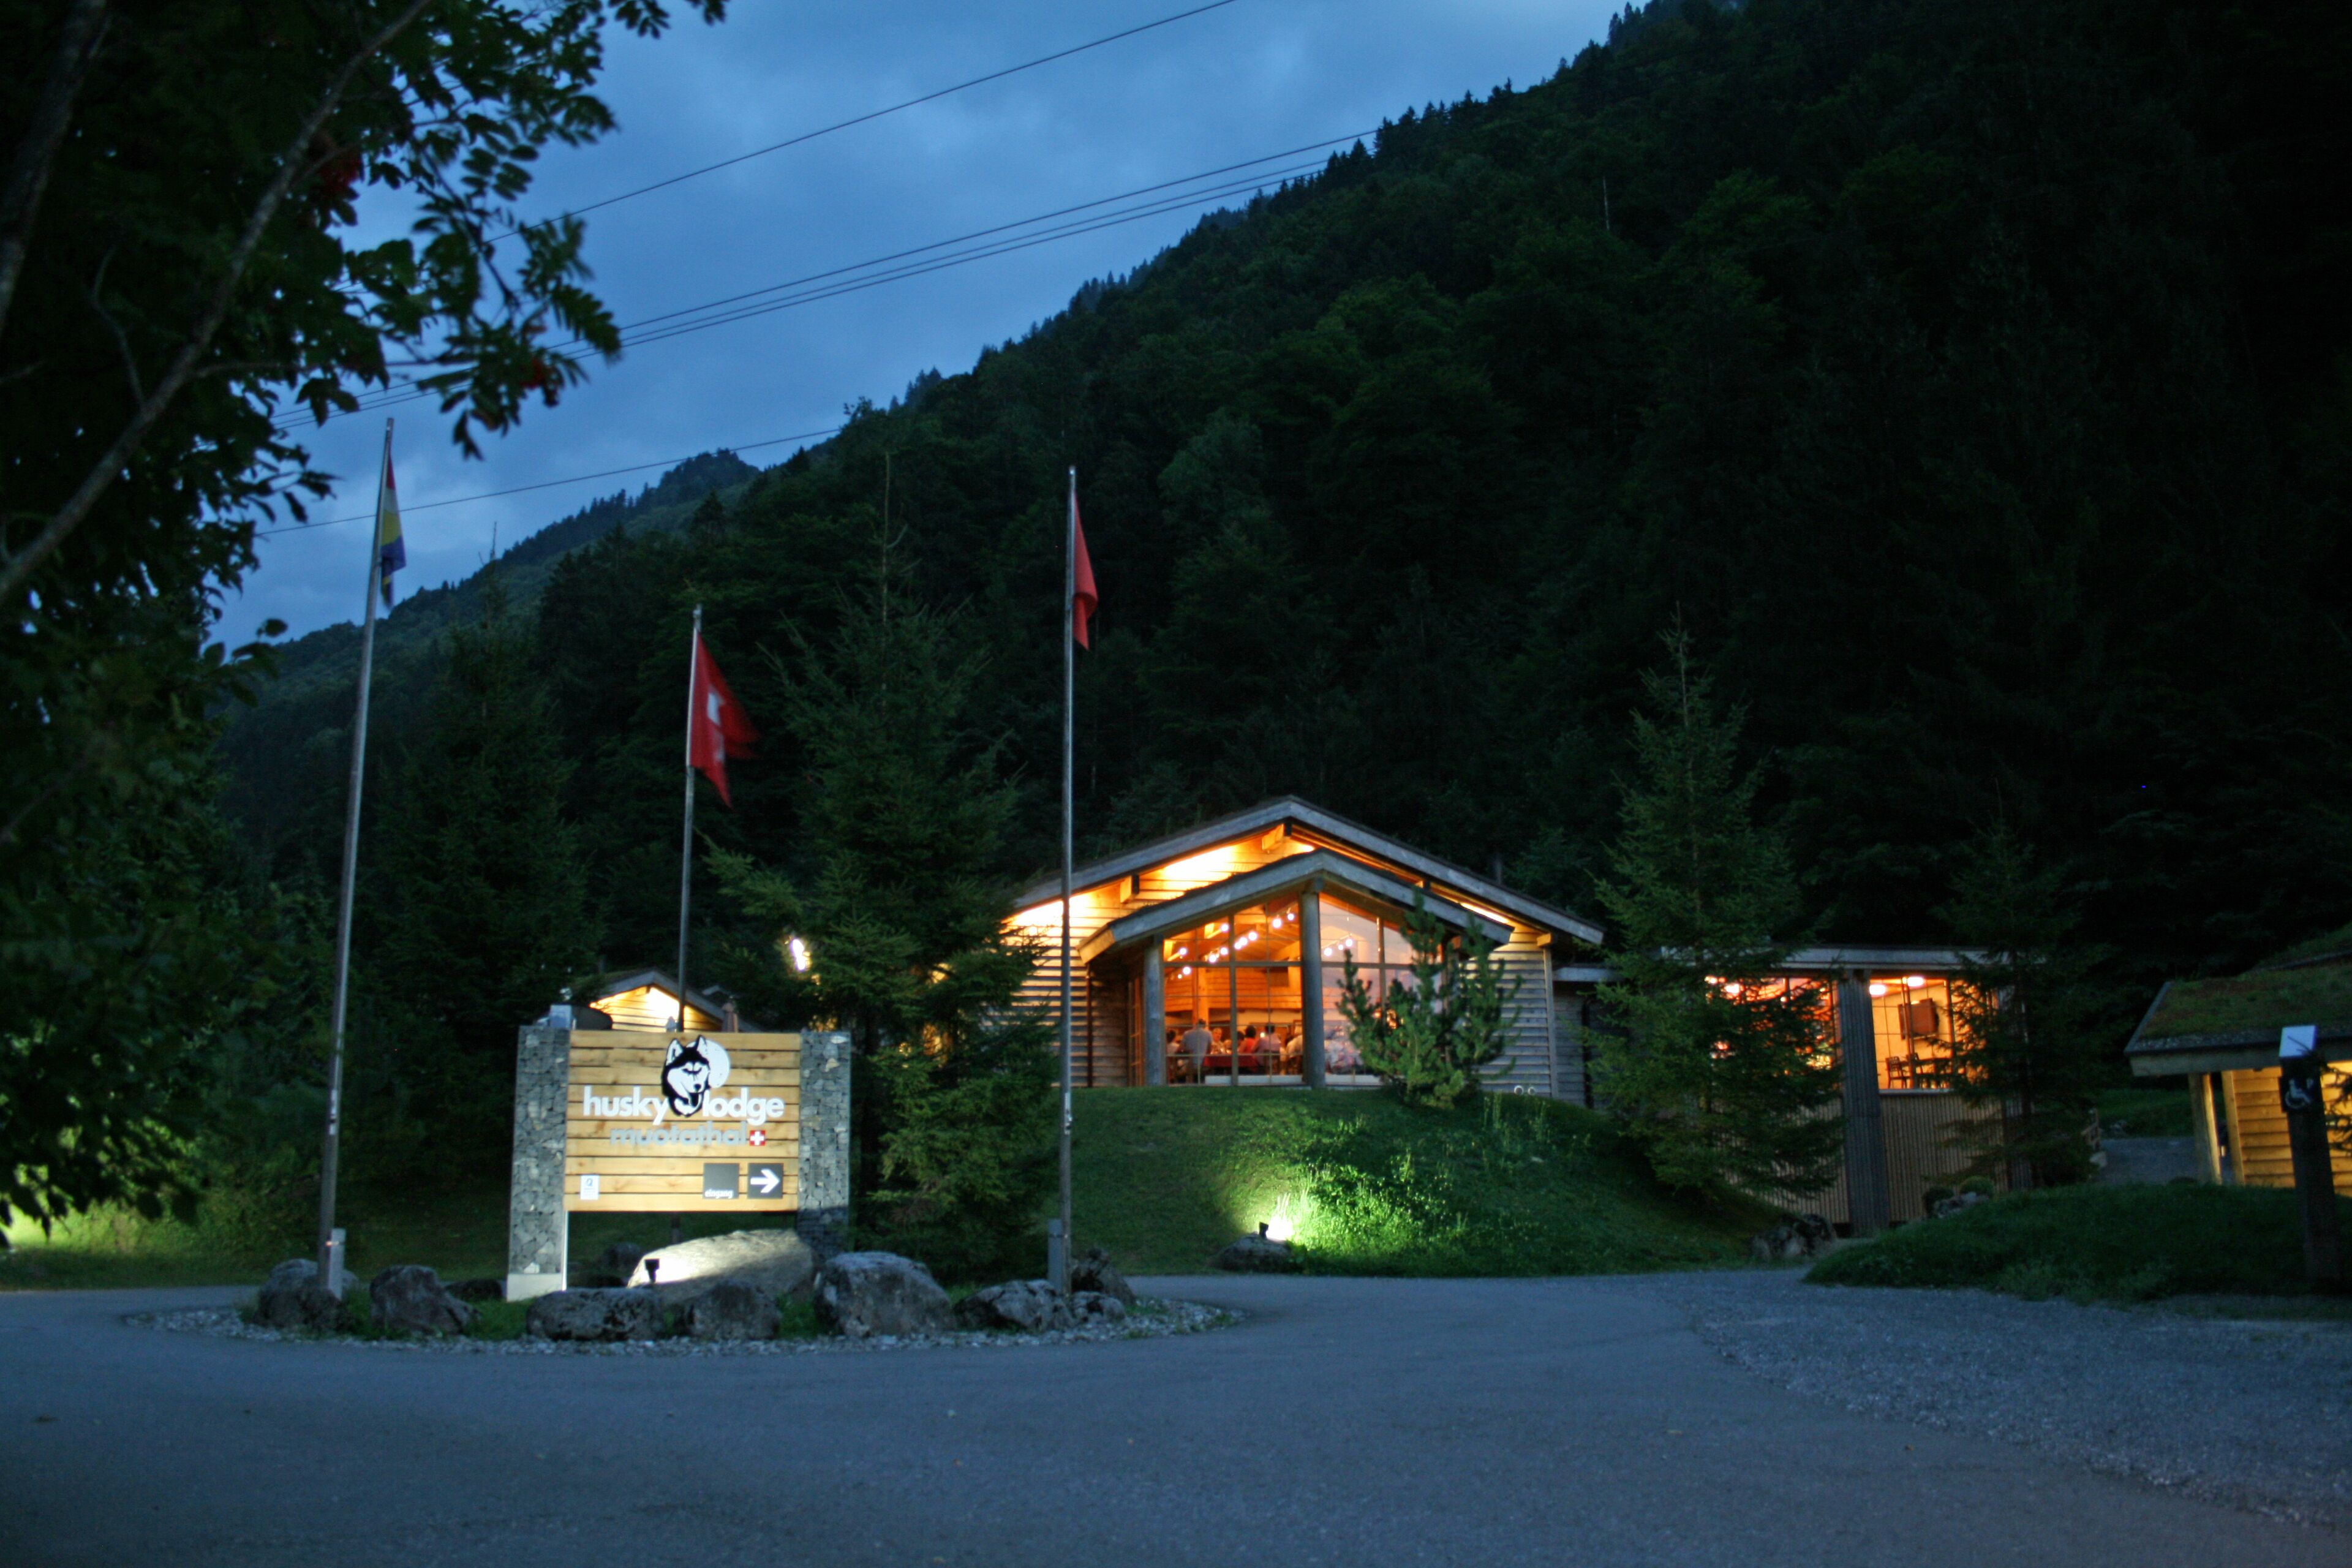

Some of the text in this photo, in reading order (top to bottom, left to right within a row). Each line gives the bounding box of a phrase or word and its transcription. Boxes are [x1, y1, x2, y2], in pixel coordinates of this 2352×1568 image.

[583, 1085, 785, 1126] husky lodge
[610, 1120, 747, 1146] muotathal
[704, 1189, 734, 1199] eingang
